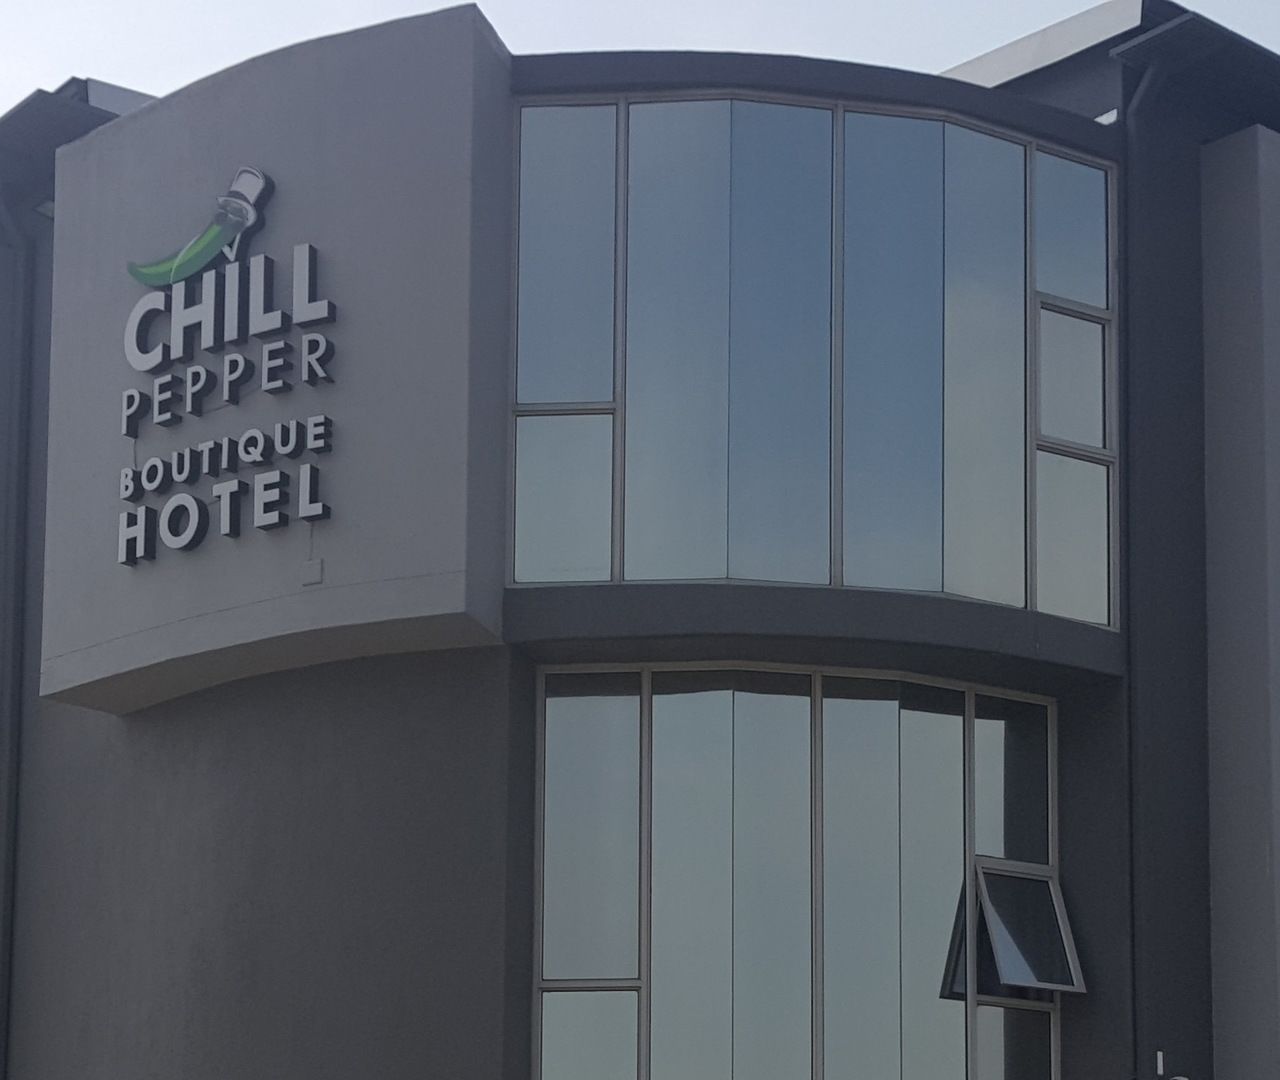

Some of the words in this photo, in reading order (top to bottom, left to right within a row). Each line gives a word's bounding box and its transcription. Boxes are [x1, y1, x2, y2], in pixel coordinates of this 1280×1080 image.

[123, 243, 330, 372] CHILL
[121, 333, 329, 437] PEPPER
[119, 415, 327, 500] BOUTIQUE
[118, 463, 325, 564] HOTEL
